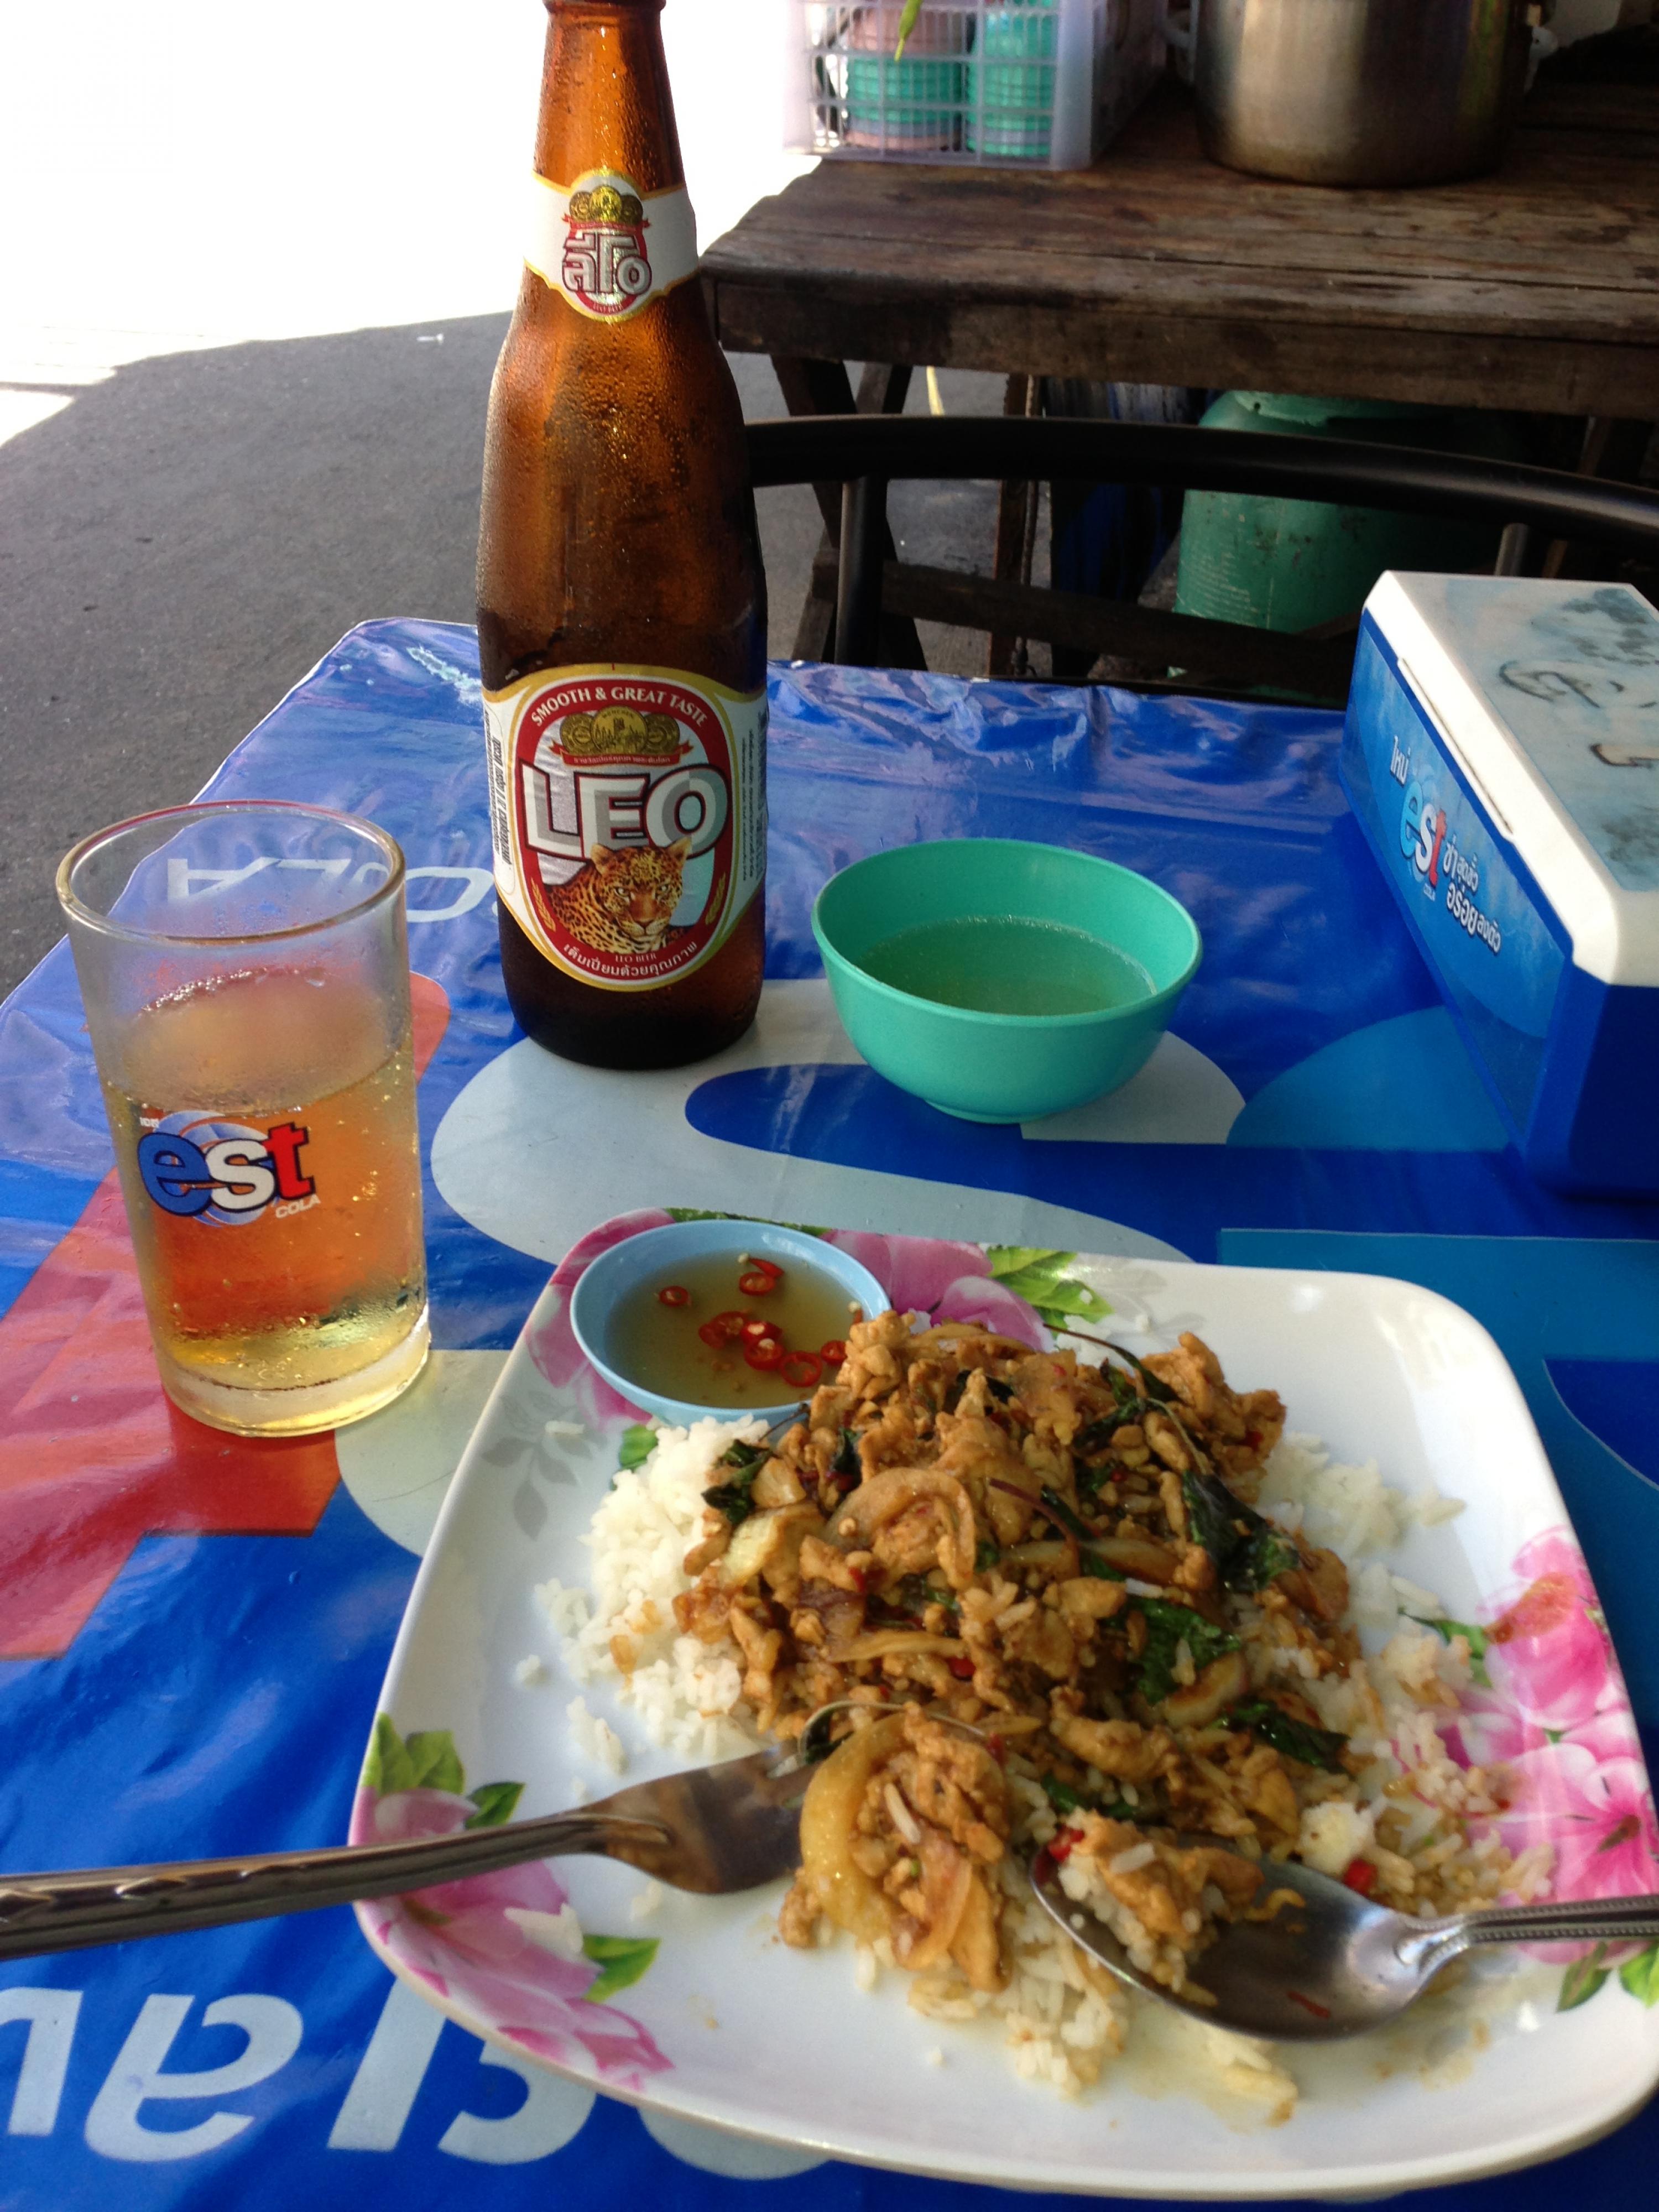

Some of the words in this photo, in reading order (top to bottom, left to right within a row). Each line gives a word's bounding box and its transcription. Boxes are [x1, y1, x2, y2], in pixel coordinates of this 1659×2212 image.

[531, 687, 591, 727] SMOOTH
[595, 687, 607, 701] &
[611, 687, 667, 705] GREAT
[670, 694, 707, 727] TASTE
[518, 763, 733, 863] LEO
[1399, 781, 1448, 886] est
[615, 954, 633, 963] LEO
[635, 952, 658, 963] BEER
[137, 1121, 316, 1217] est
[276, 1193, 321, 1219] COLA
